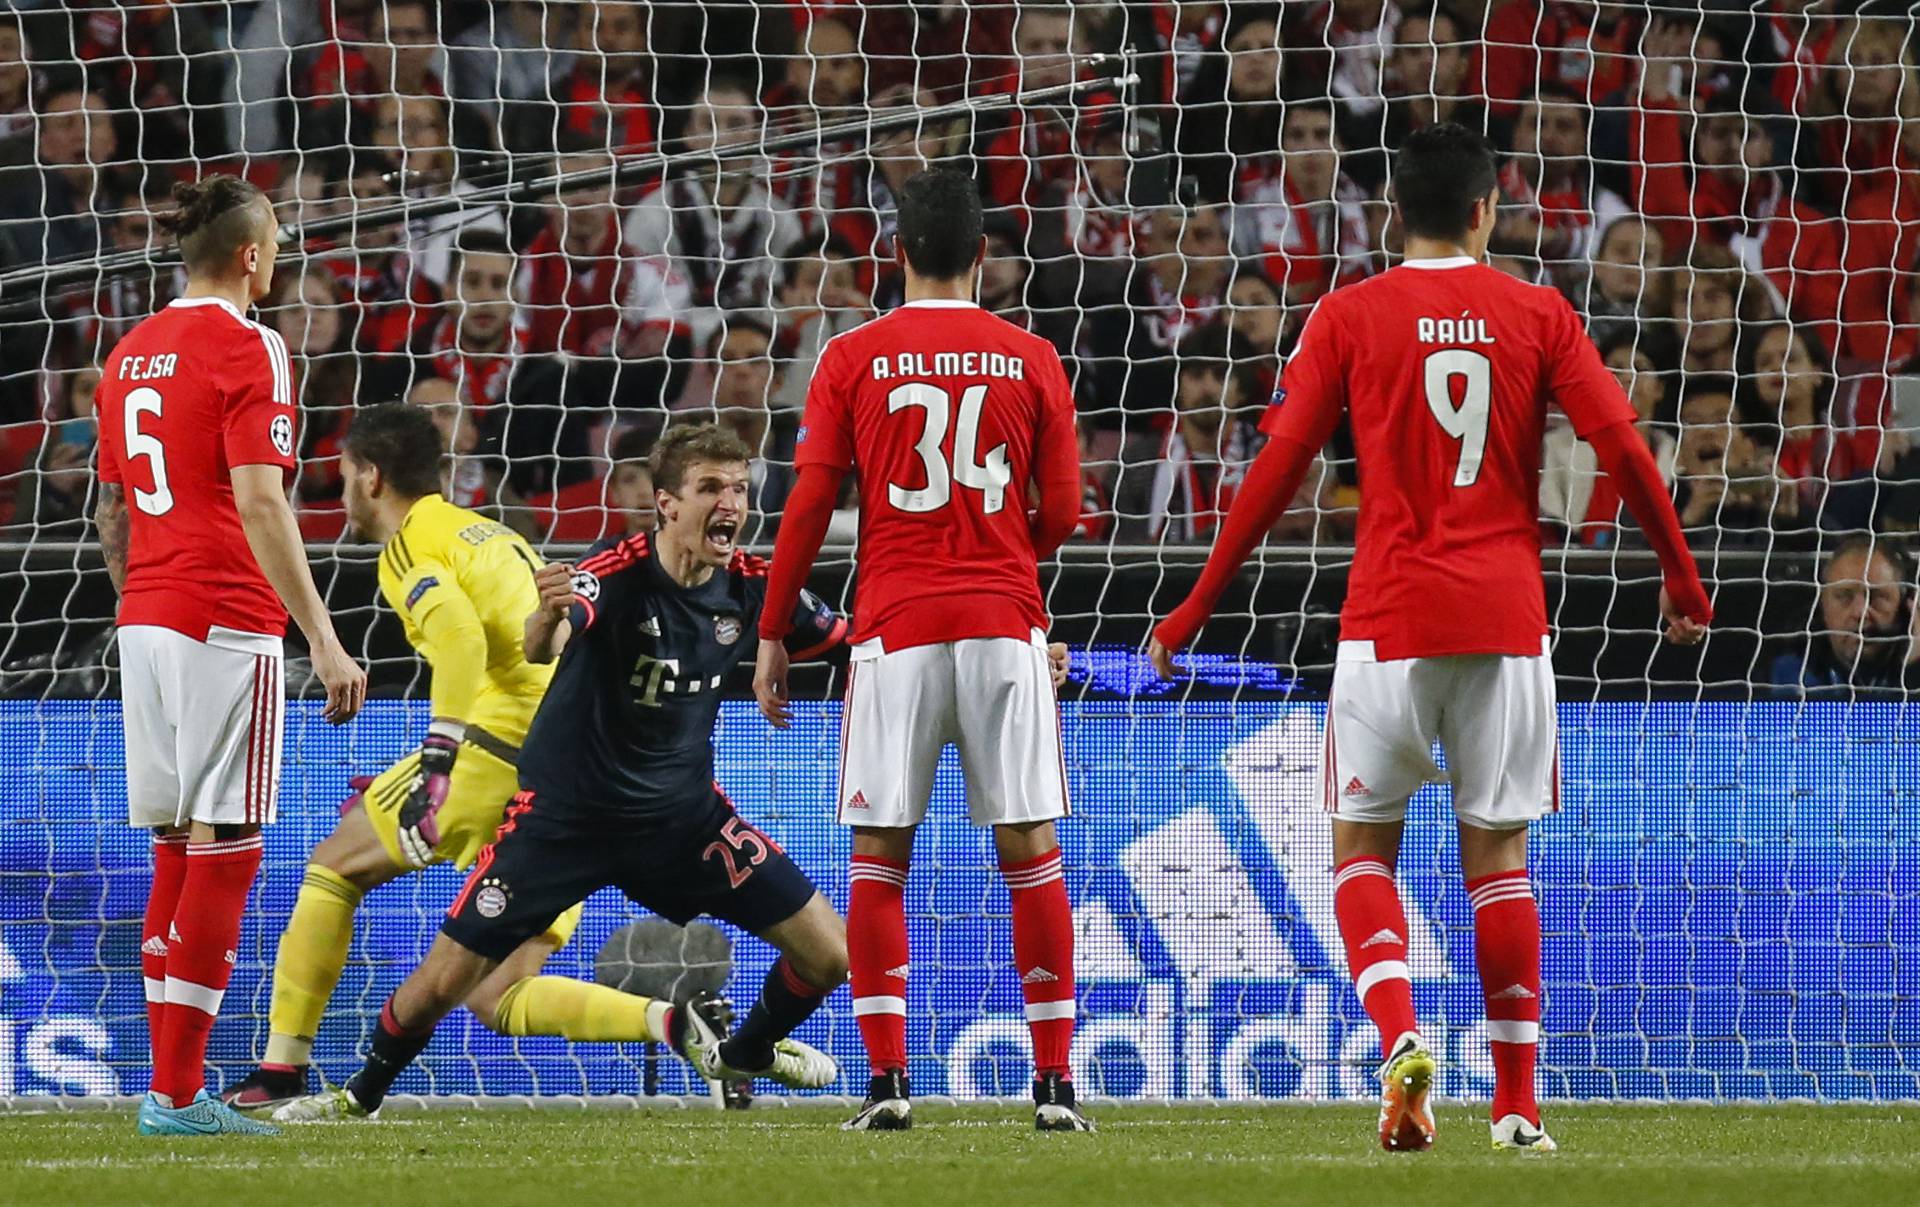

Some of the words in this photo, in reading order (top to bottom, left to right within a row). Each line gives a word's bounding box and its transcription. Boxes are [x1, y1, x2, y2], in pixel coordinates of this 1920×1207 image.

[1417, 310, 1496, 344] RAÚL
[118, 353, 178, 380] FEJSA
[872, 352, 1024, 380] A.ALMEIDA
[124, 386, 175, 516] 5
[887, 382, 1011, 515] 34
[1423, 348, 1492, 488] 9
[703, 816, 770, 889] 25
